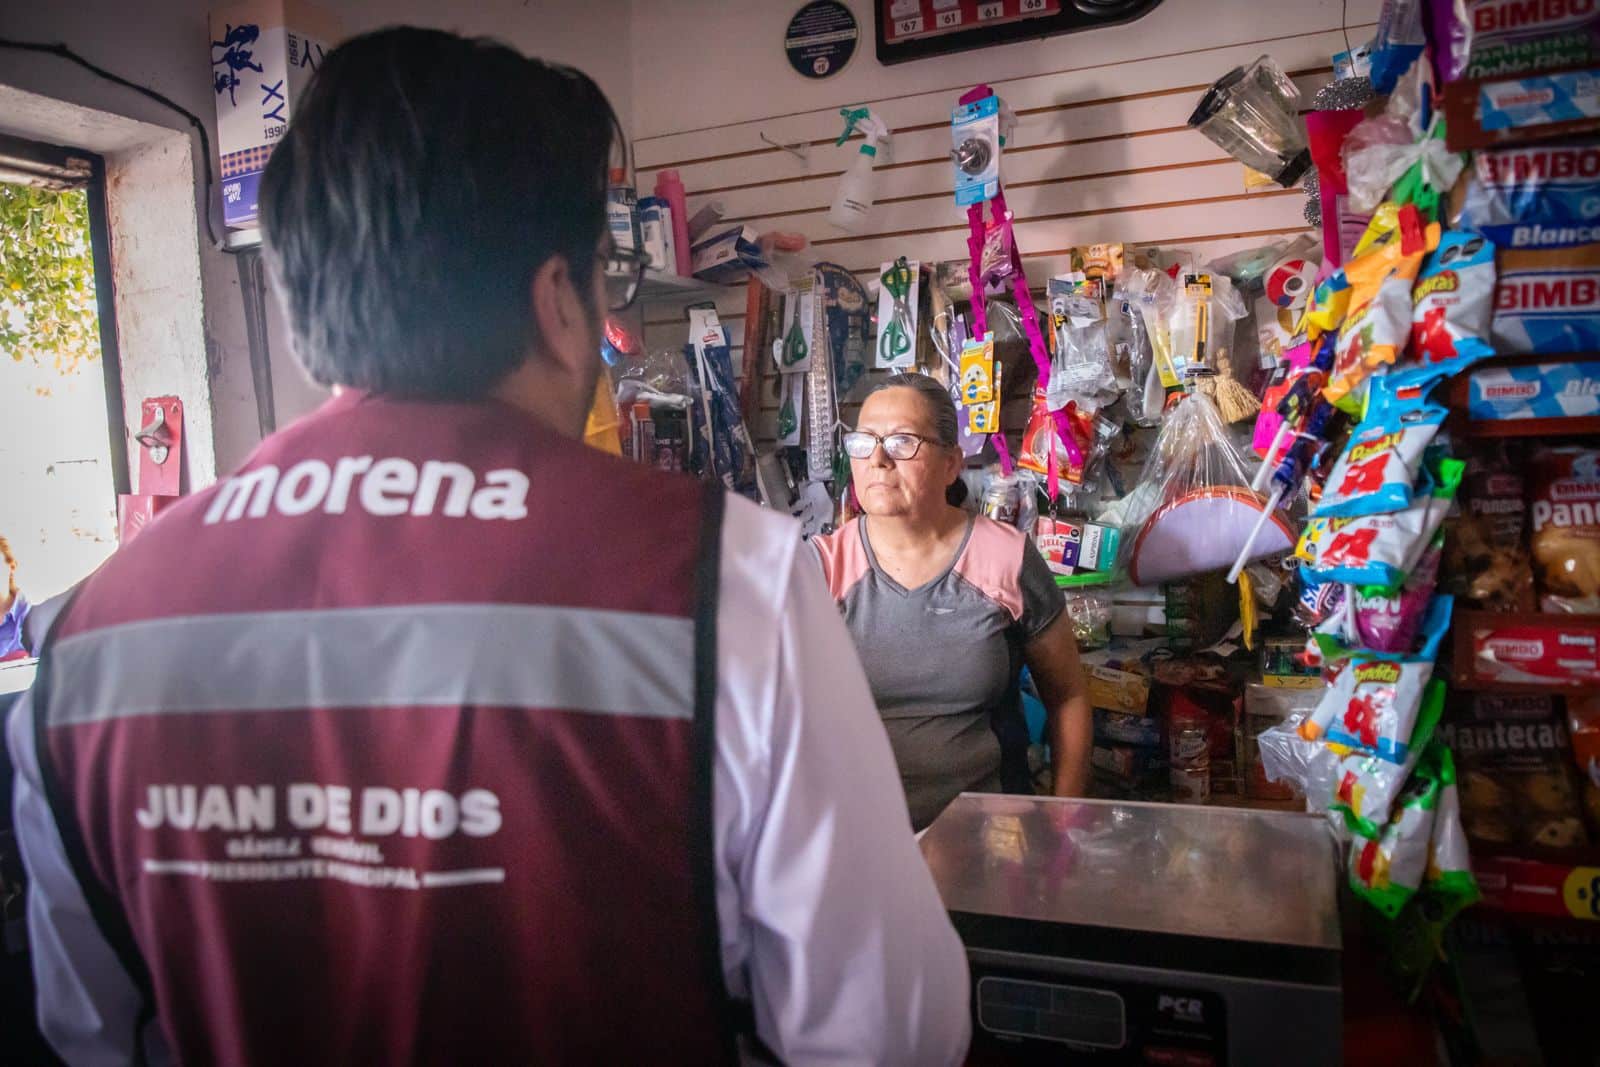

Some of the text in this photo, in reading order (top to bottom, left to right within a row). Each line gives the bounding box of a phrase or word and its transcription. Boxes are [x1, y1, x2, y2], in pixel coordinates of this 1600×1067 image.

[1475, 0, 1593, 32] BIMBO
[204, 456, 530, 526] morena
[137, 784, 502, 839] JUAN DE DIOS
